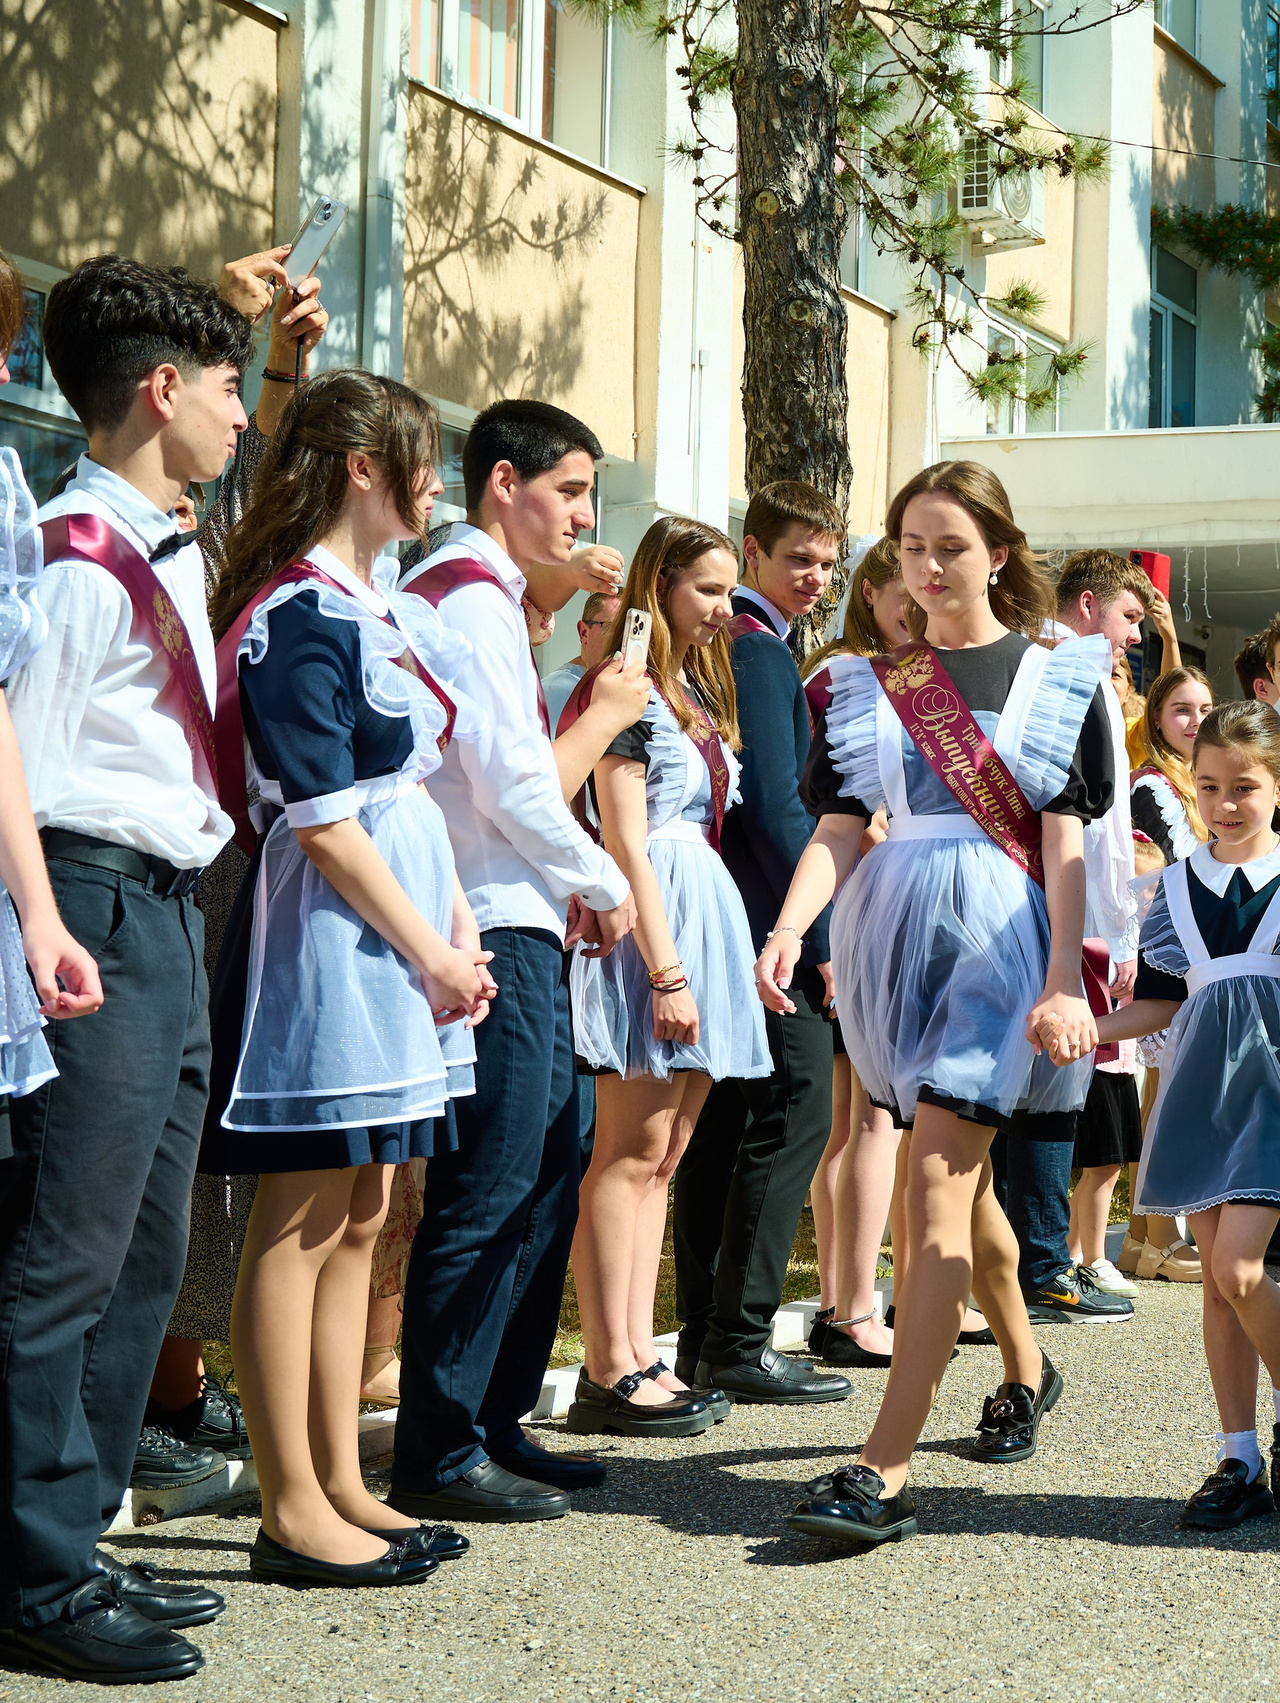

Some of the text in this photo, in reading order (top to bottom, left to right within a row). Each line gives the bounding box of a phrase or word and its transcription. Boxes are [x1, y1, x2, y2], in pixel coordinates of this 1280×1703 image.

[920, 740, 937, 760] класс
[944, 772, 961, 790] МБОУ
[955, 786, 970, 802] СОШ
[1002, 787, 1027, 819] Лина
